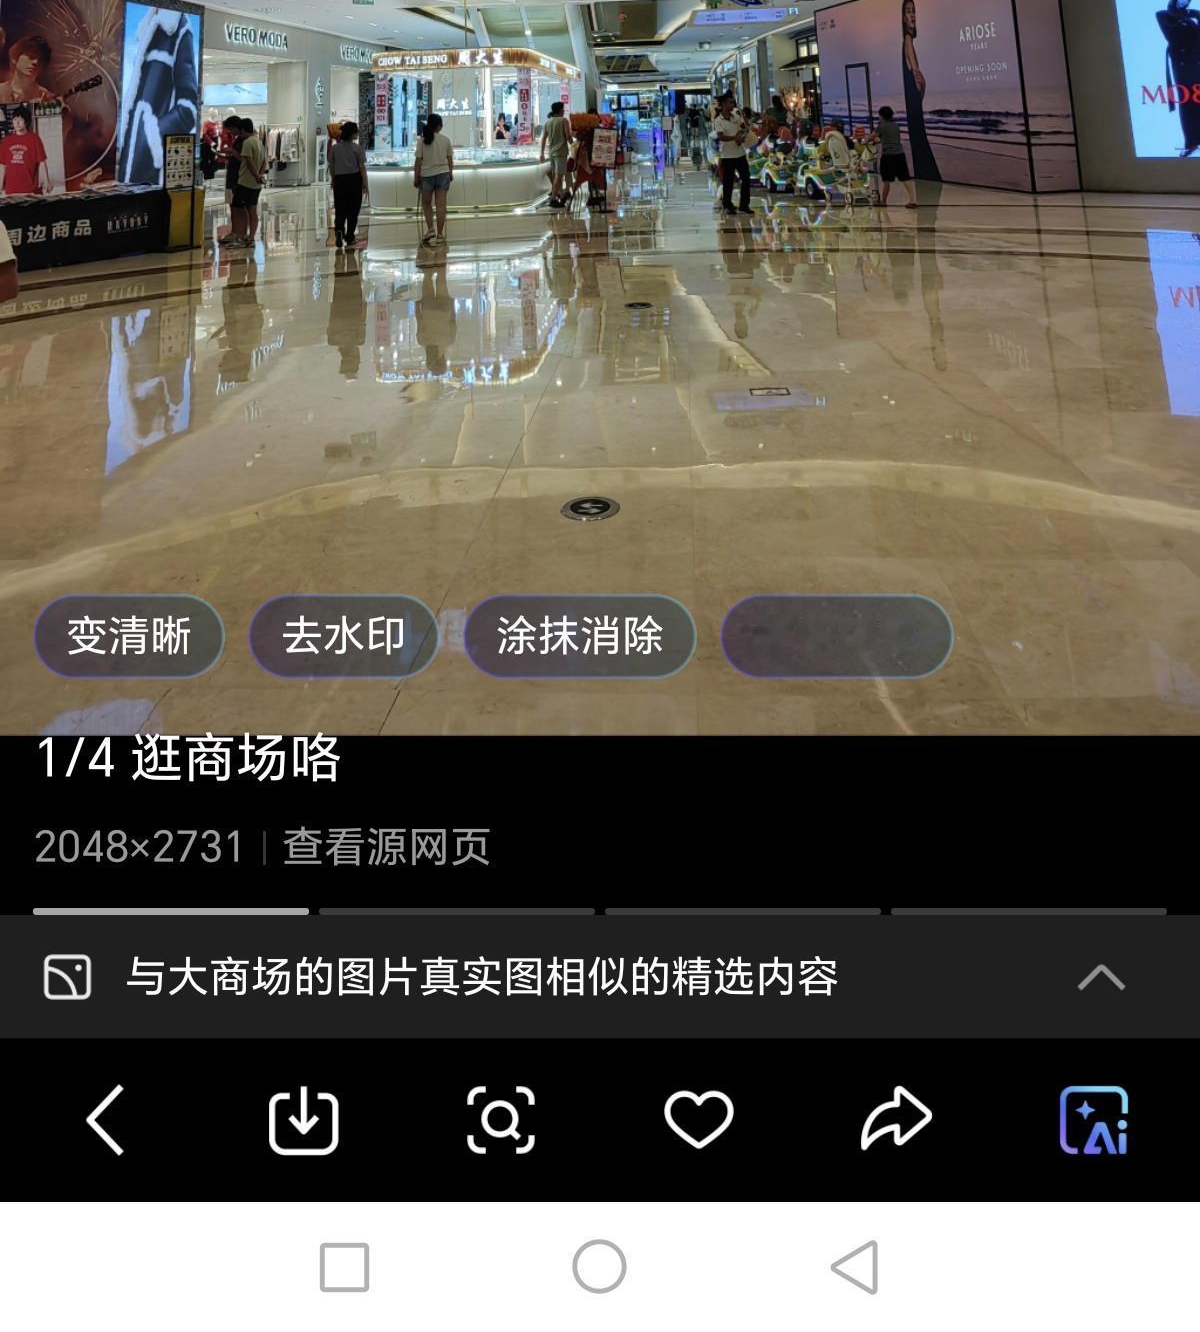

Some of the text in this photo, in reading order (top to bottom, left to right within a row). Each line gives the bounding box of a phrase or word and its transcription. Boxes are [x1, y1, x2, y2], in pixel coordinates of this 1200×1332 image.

[224, 22, 288, 51] VERO MODA
[960, 22, 996, 42] ARIOSE
[340, 45, 359, 61] VERO
[378, 56, 401, 66] CHOW
[404, 55, 420, 65] TAI
[422, 54, 448, 64] SENG
[955, 61, 1007, 75] OPENING SOON
[8, 219, 92, 247] 周边商品
